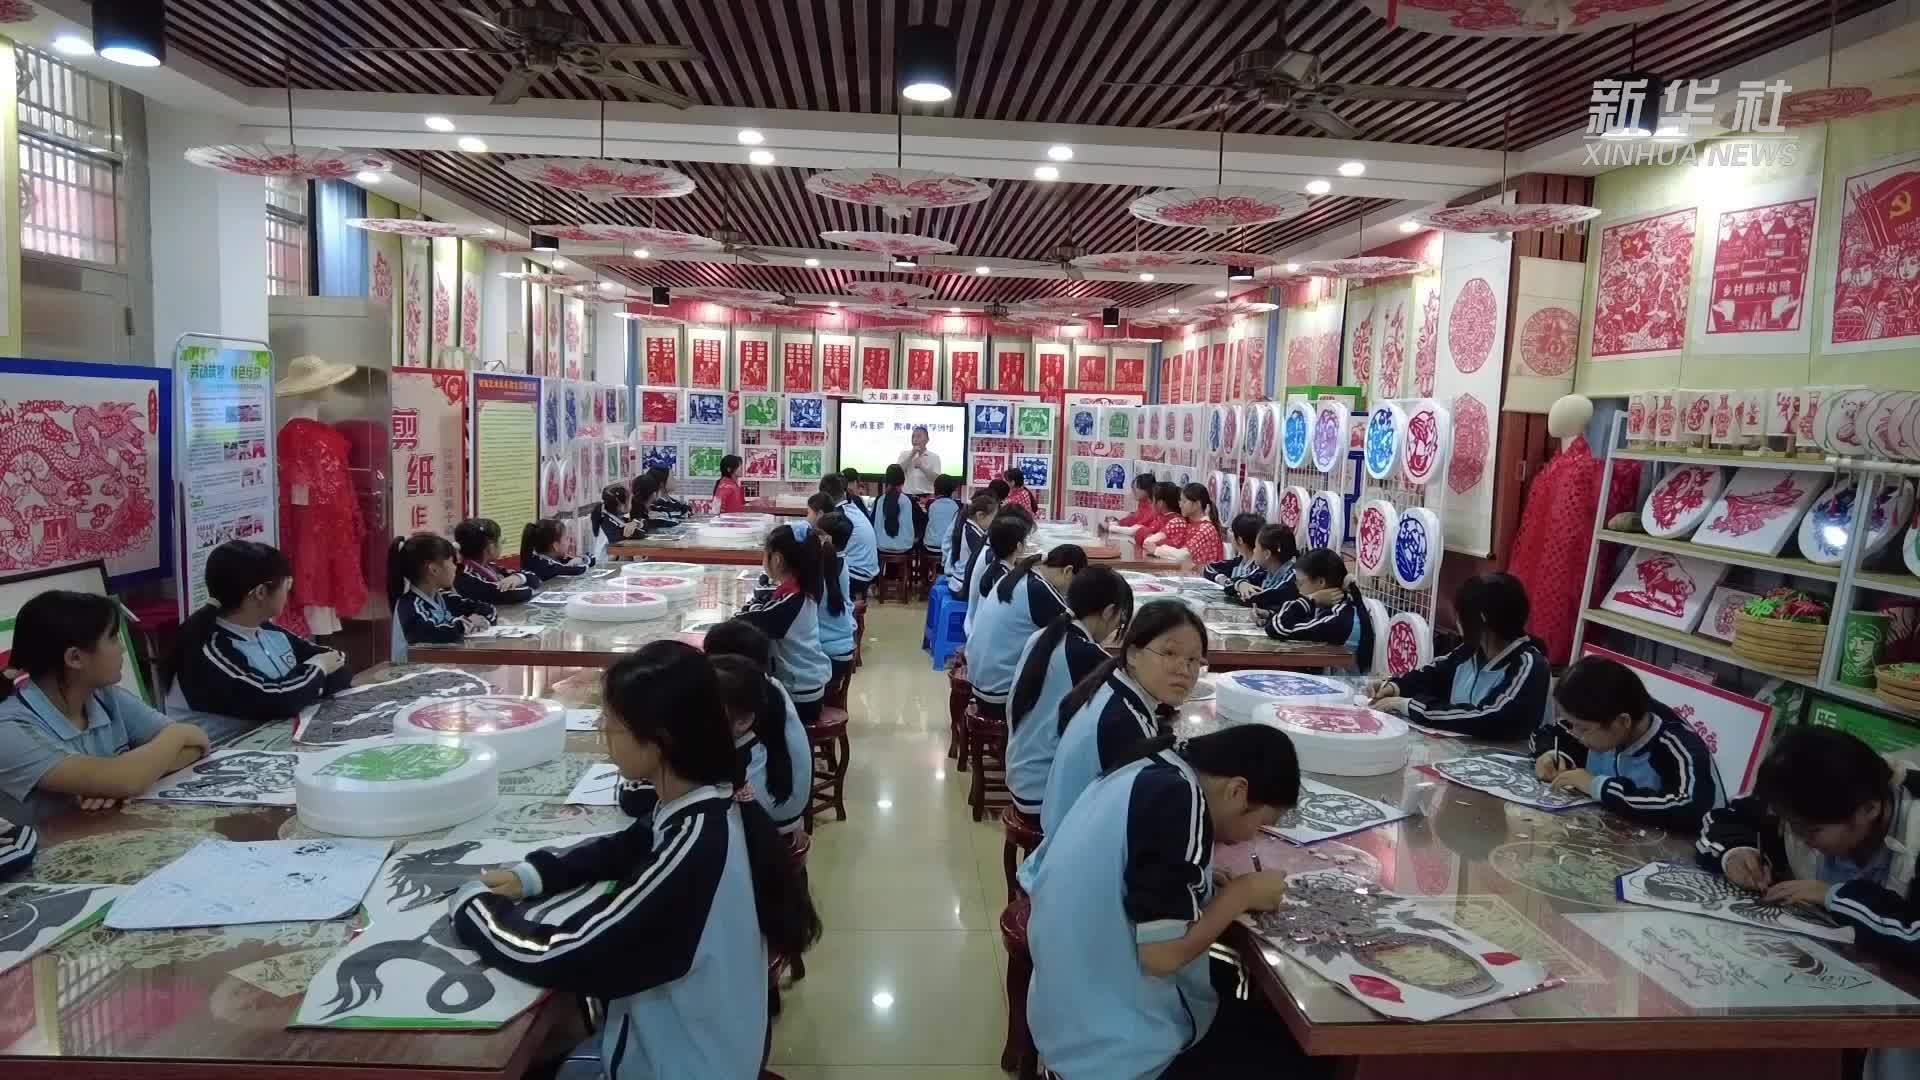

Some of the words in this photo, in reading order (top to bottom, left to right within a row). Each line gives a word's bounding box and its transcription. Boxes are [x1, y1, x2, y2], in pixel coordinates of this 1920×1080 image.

[1723, 280, 1792, 298] 乡村振兴战略
